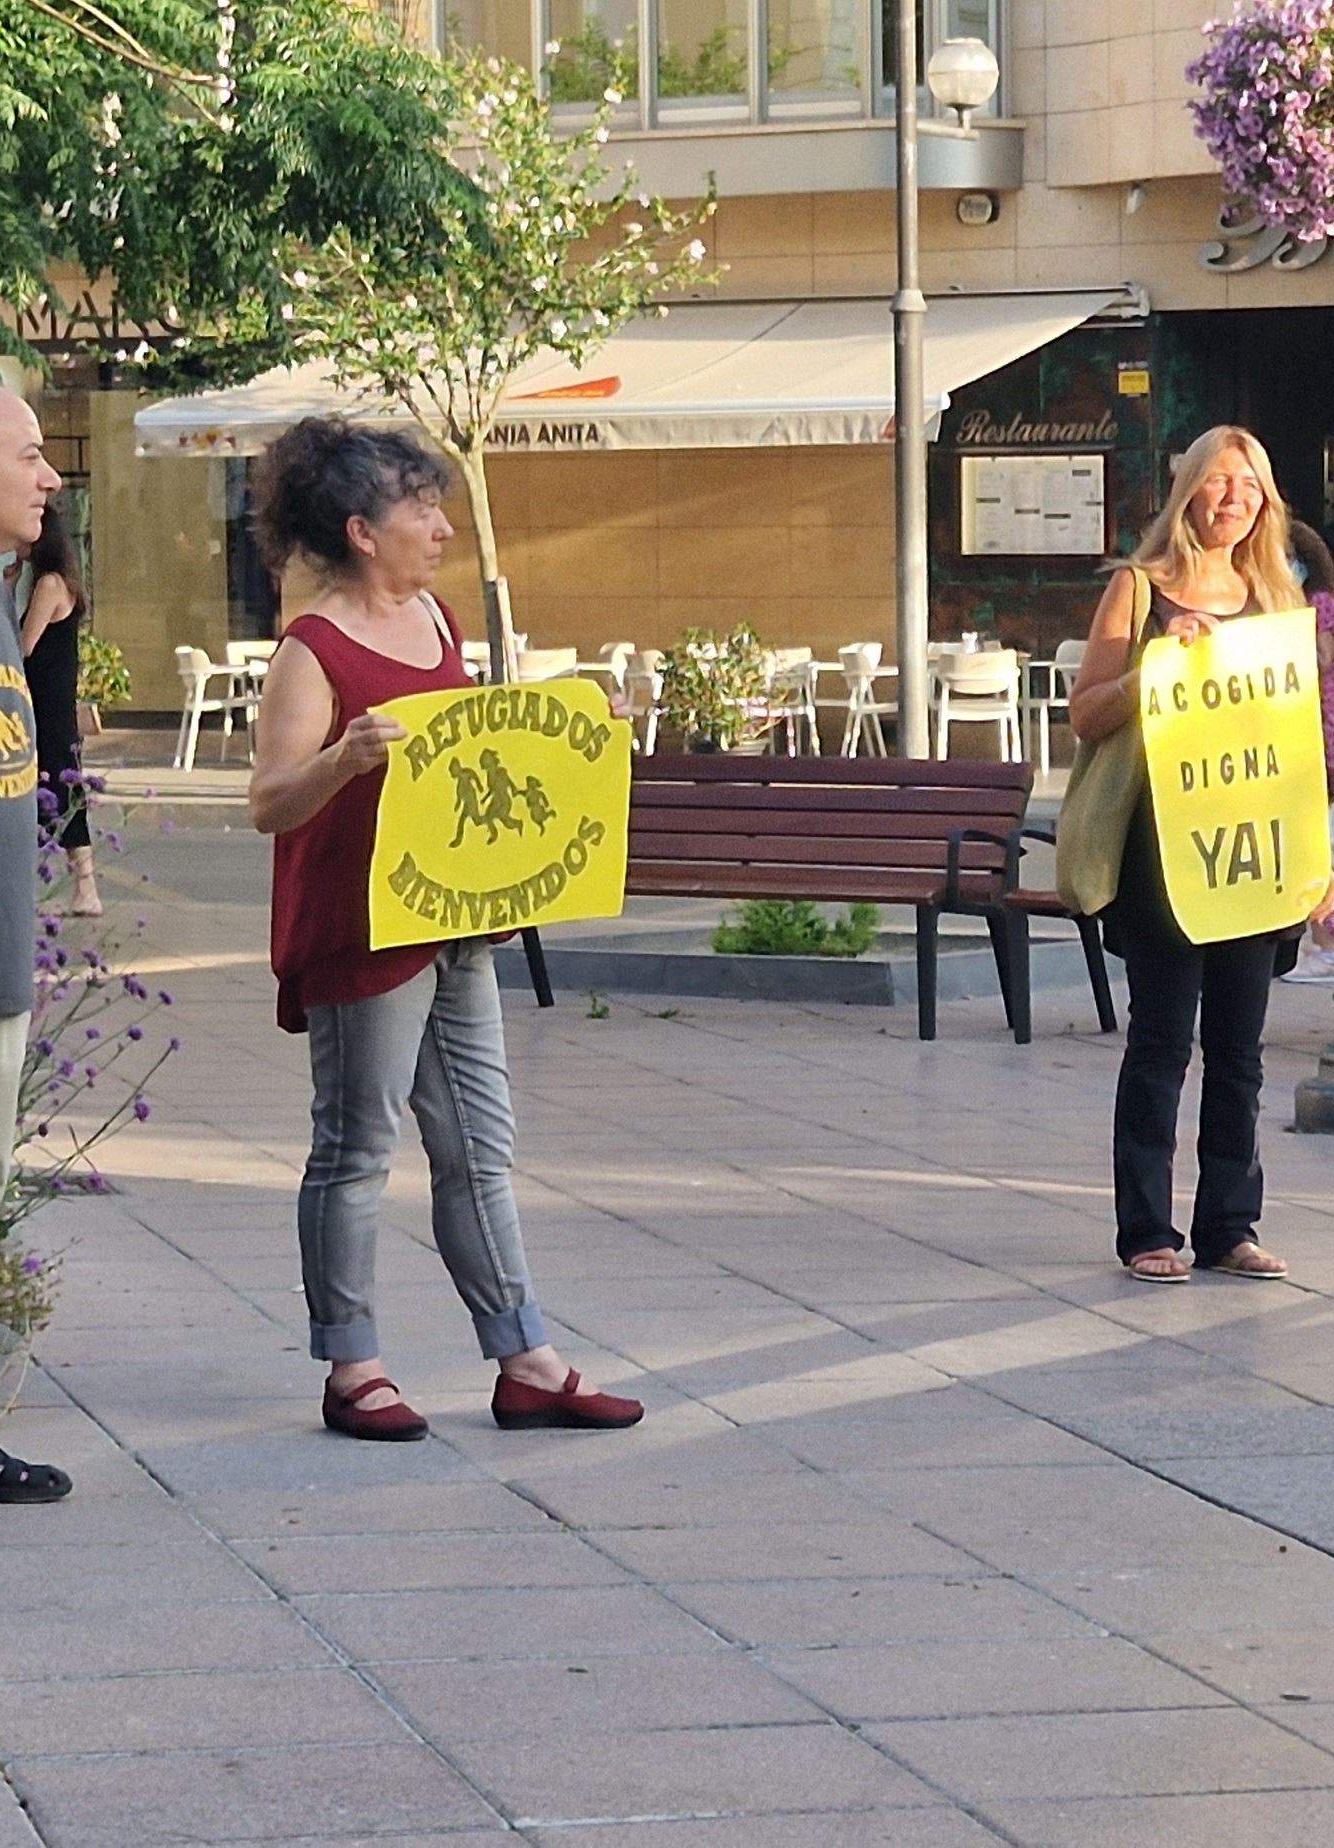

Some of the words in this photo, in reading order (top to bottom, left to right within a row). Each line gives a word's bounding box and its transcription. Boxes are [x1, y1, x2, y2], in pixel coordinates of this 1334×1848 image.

[484, 423, 531, 446] ANJA
[537, 421, 599, 444] ANITA
[955, 408, 1120, 444] Restaurante
[1147, 661, 1301, 716] ACOGIDA
[403, 687, 612, 782] REFUGIADOS
[1180, 742, 1281, 793] DIGNA
[386, 814, 607, 931] BIENVENIDOS
[1191, 819, 1284, 895] YA!
